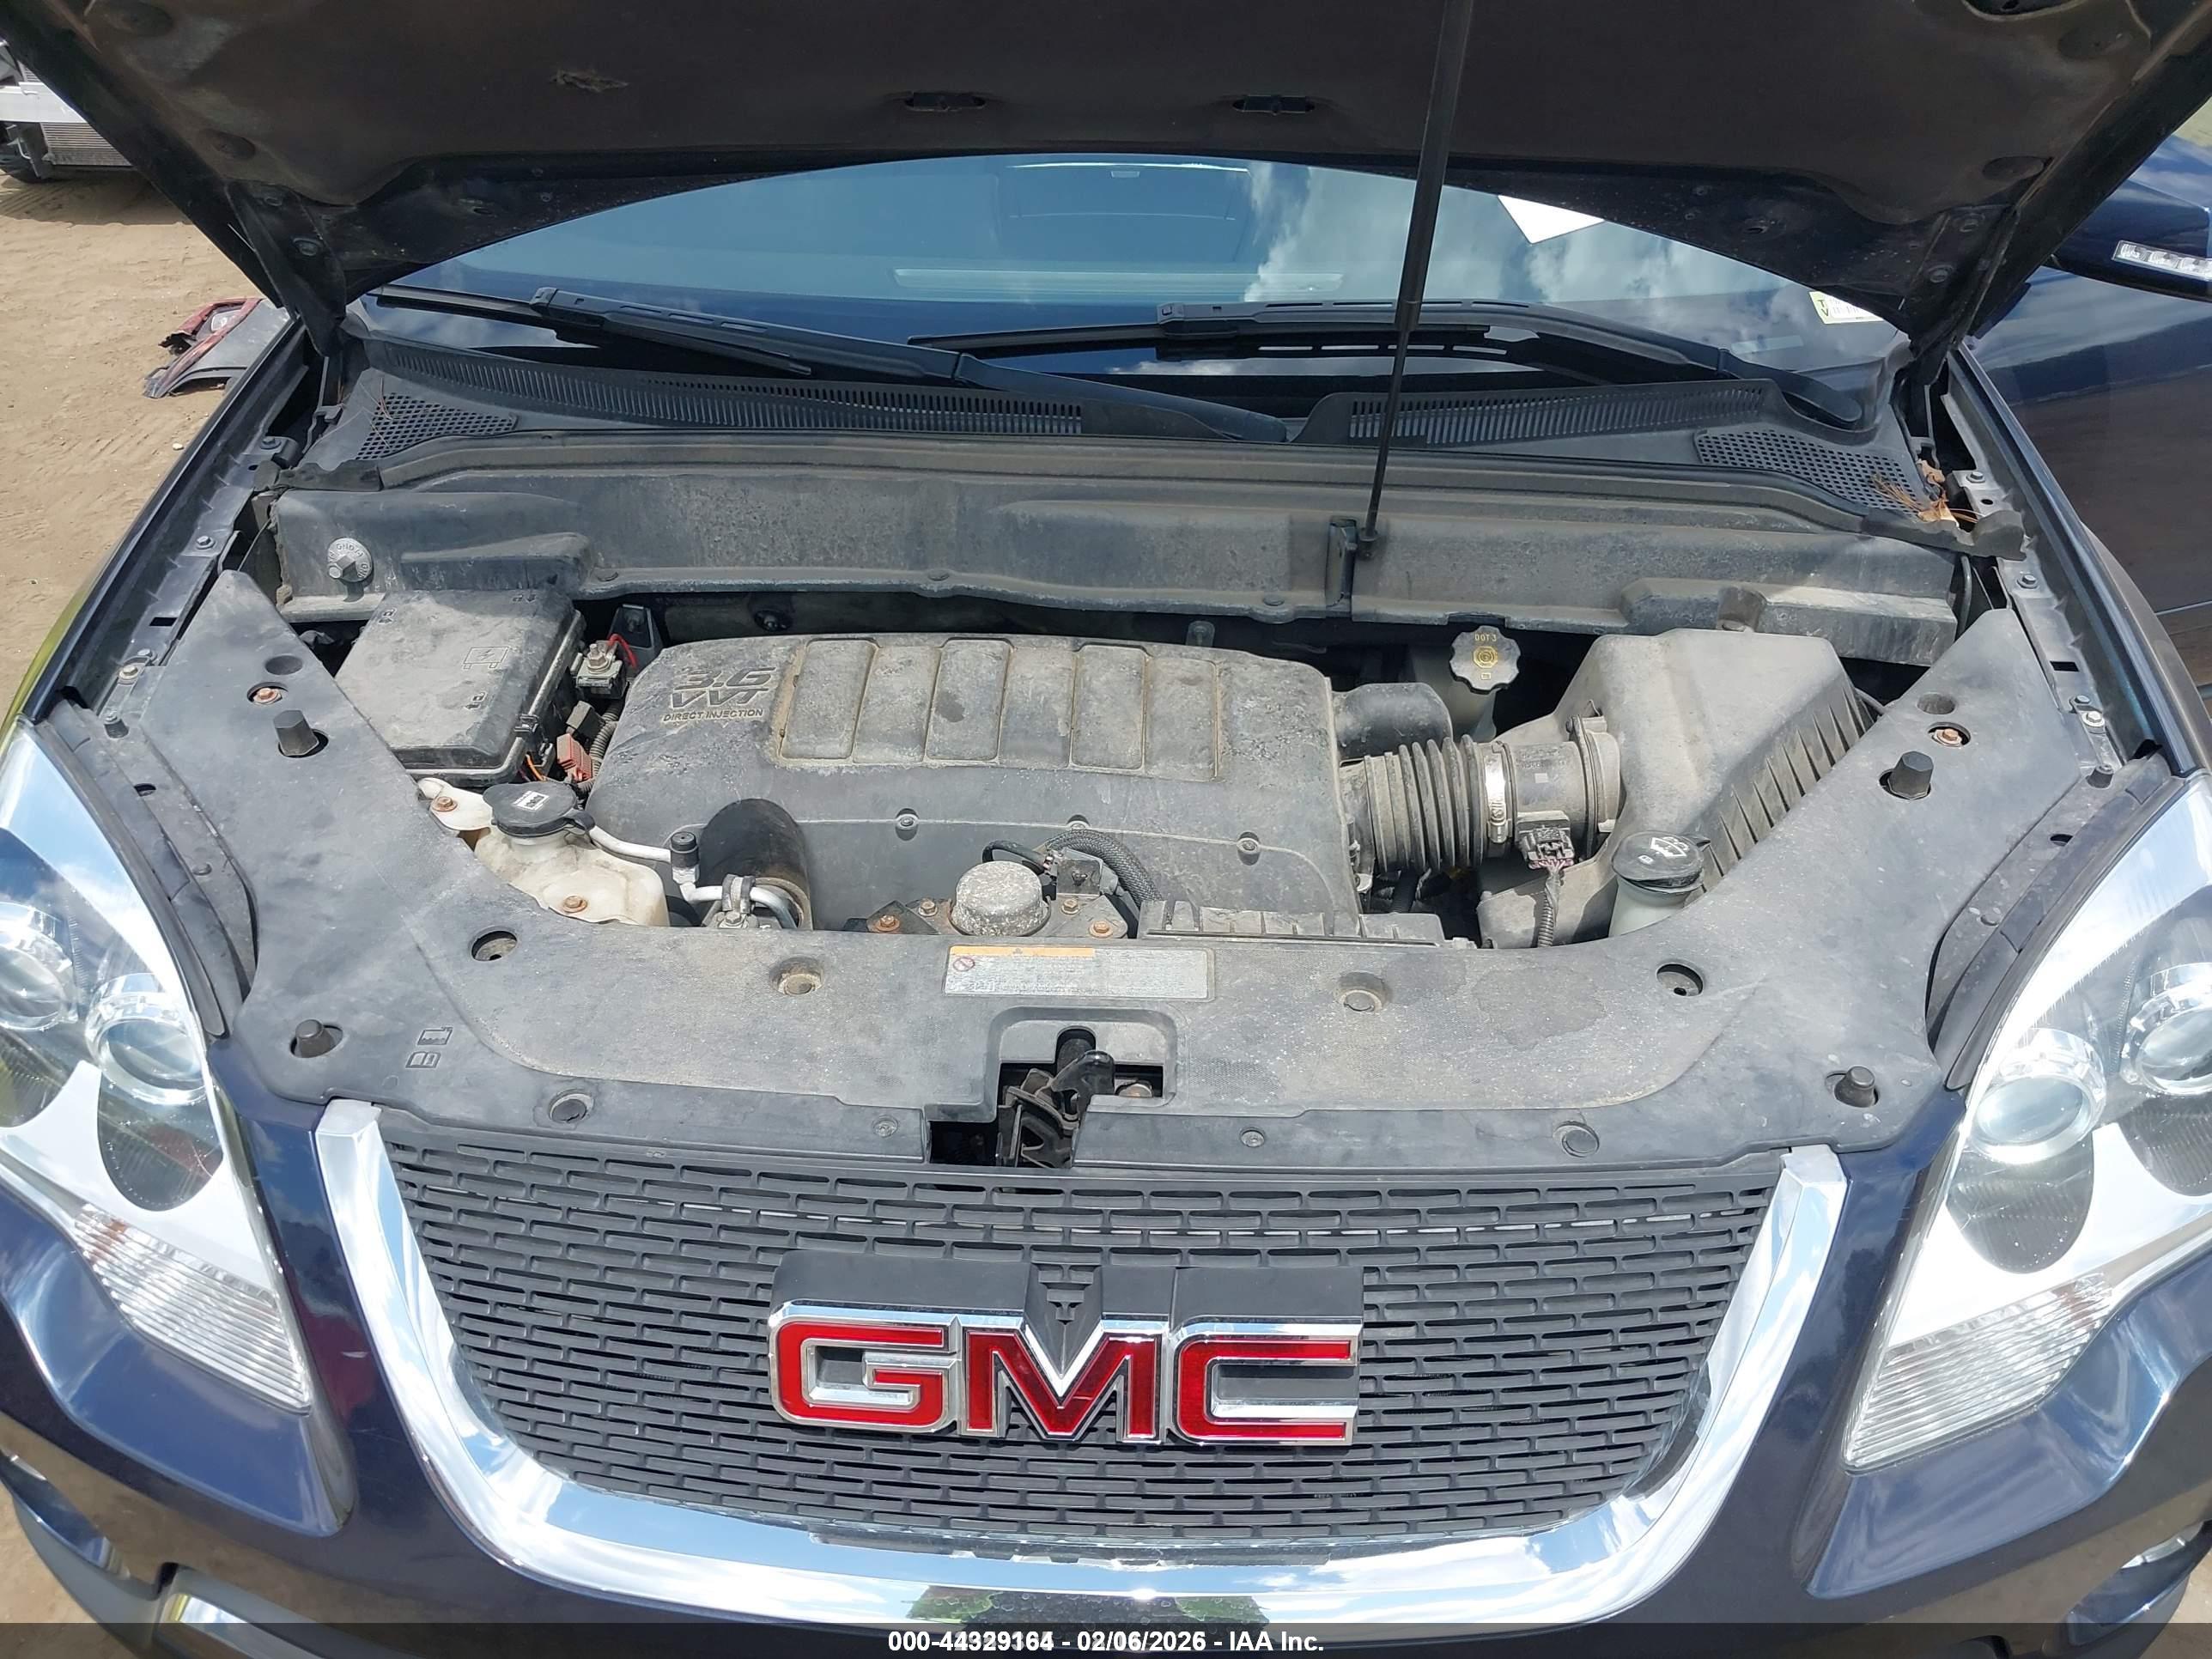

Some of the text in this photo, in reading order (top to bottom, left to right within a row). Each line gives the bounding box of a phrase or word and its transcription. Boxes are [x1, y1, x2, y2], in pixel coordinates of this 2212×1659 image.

[1492, 634, 1498, 642] 3
[674, 666, 777, 690] 3.6
[670, 688, 770, 709] VVT
[662, 709, 764, 723] DIRECT INJECTION
[768, 1302, 1363, 1448] GMC
